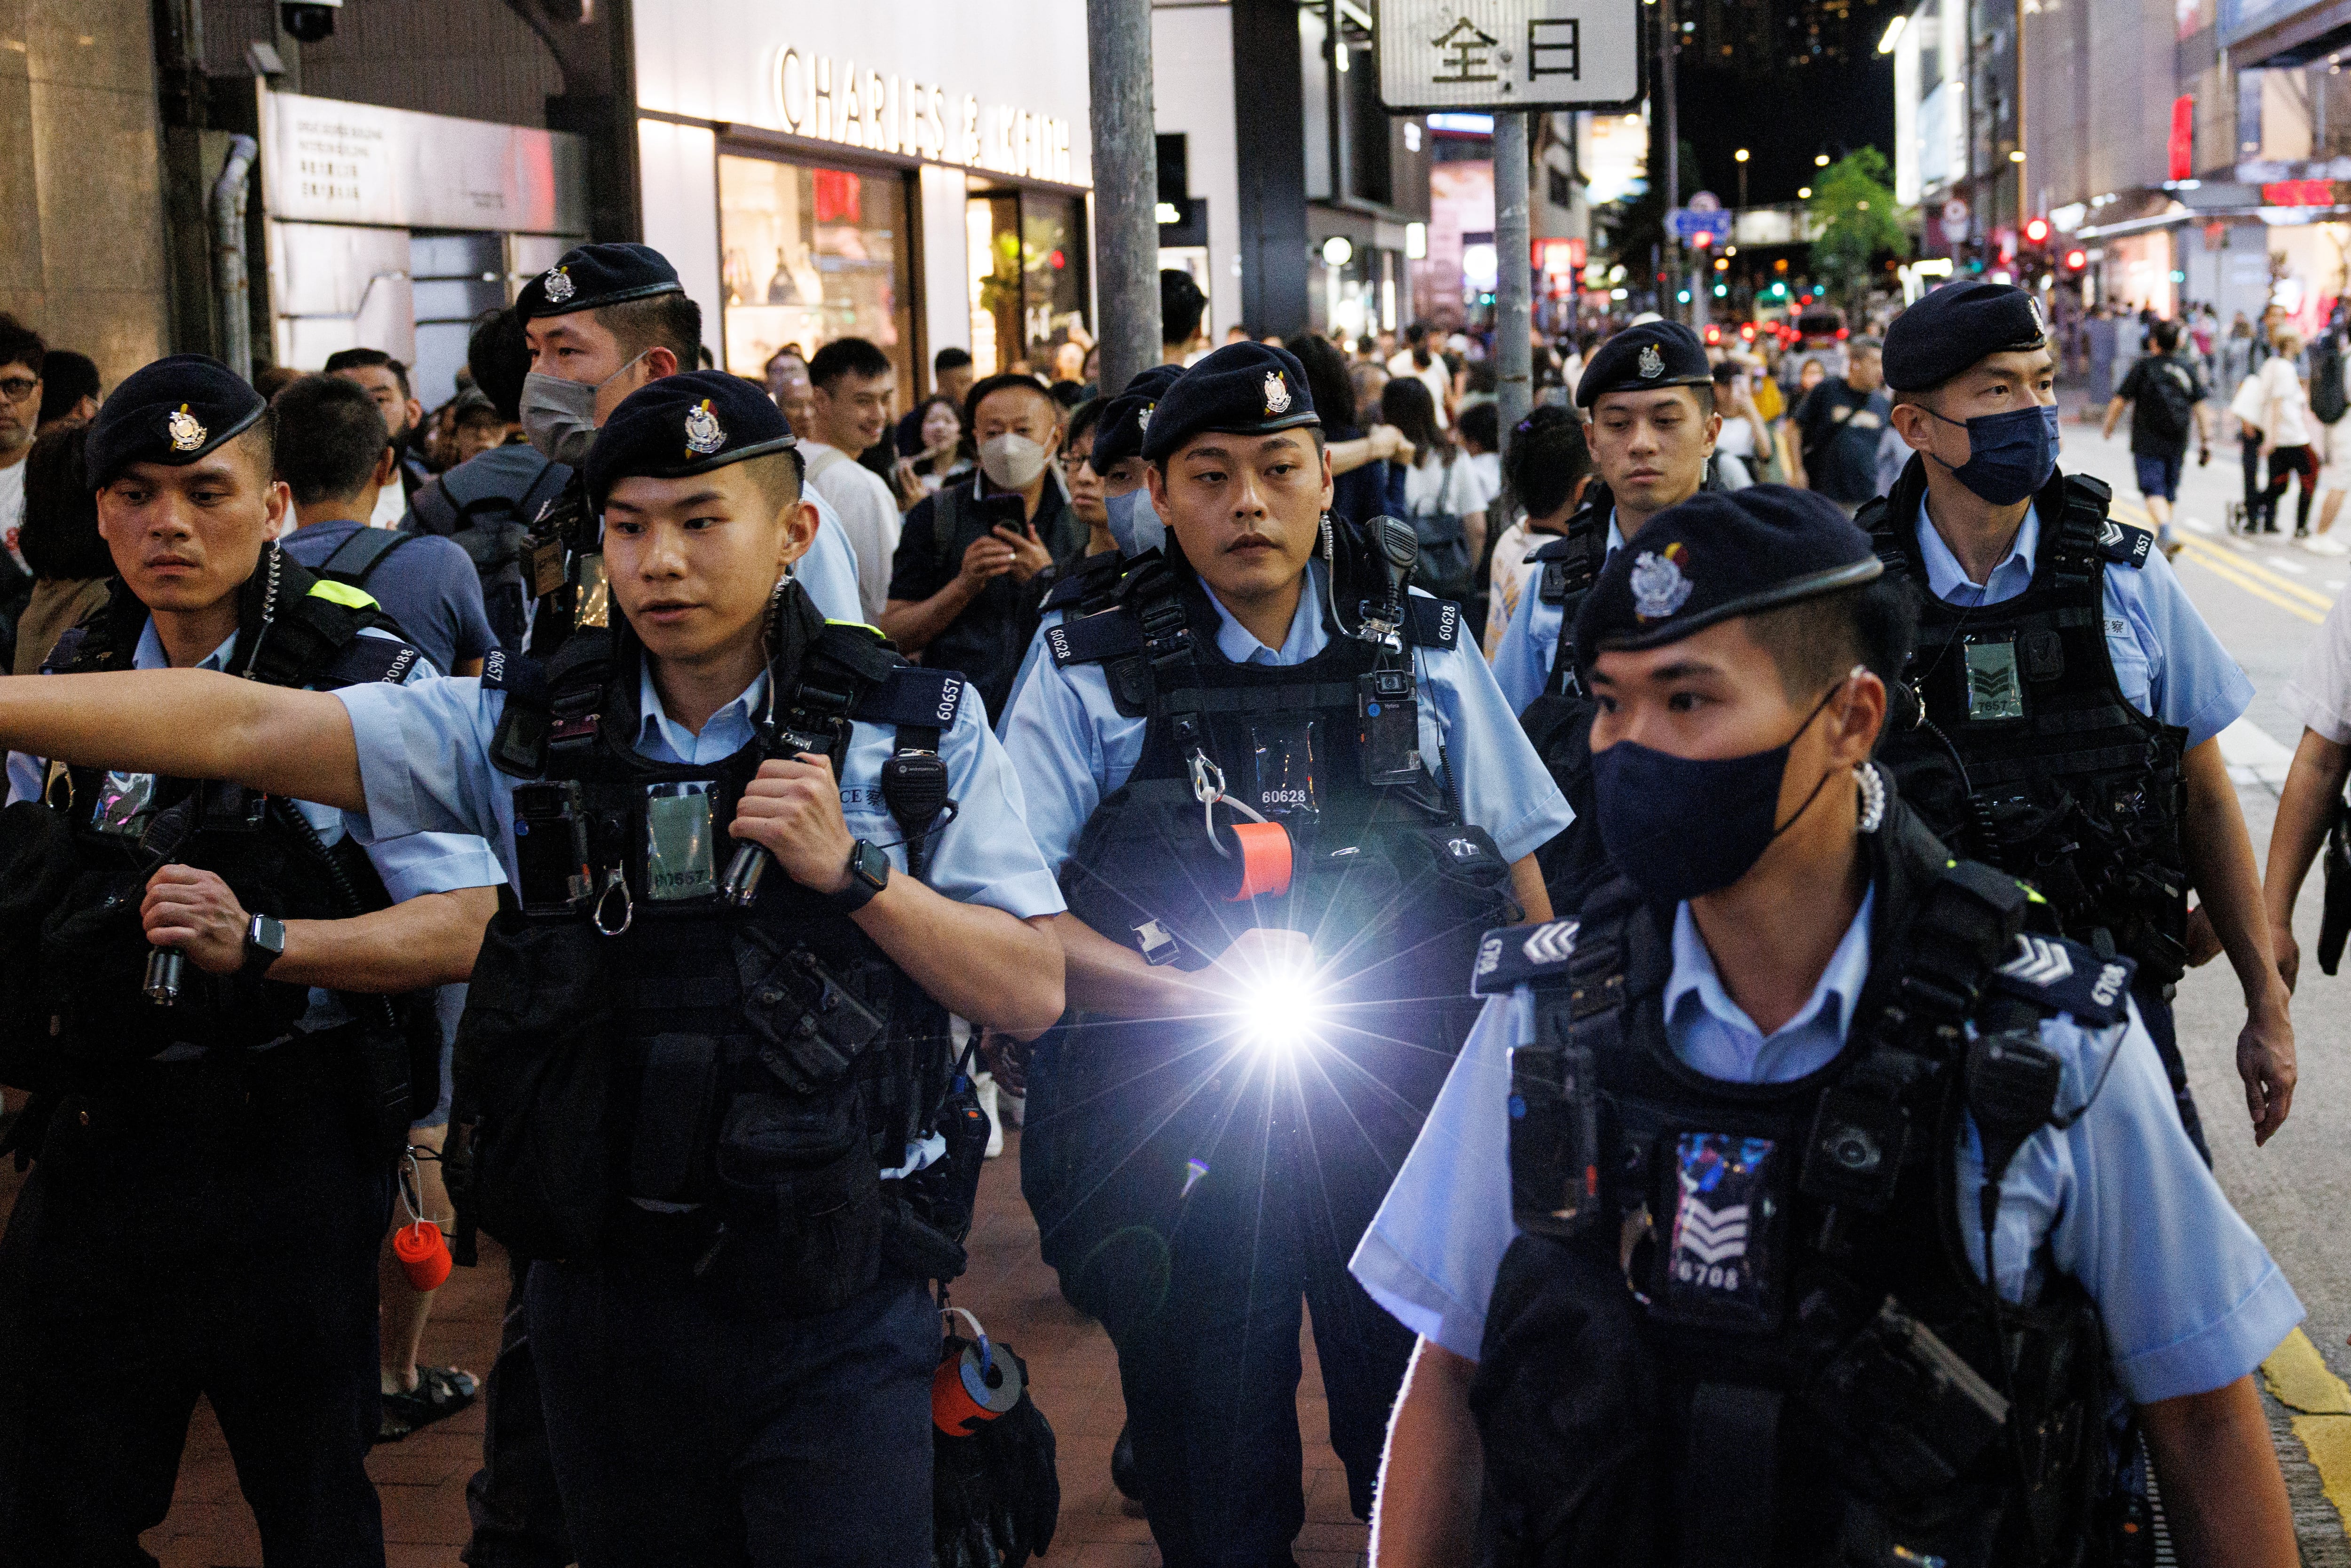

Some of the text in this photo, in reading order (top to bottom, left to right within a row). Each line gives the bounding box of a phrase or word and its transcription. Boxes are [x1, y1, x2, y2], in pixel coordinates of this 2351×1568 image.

[1431, 16, 1580, 82] 全日
[773, 42, 945, 161] CHARLES
[2133, 534, 2151, 556] 7657
[1439, 606, 1456, 640] 60628
[1050, 629, 1071, 659] 60628
[487, 651, 506, 681] 60657
[936, 678, 961, 720] 60657
[1262, 790, 1306, 803] 60628
[1678, 1260, 1739, 1292] 6708
